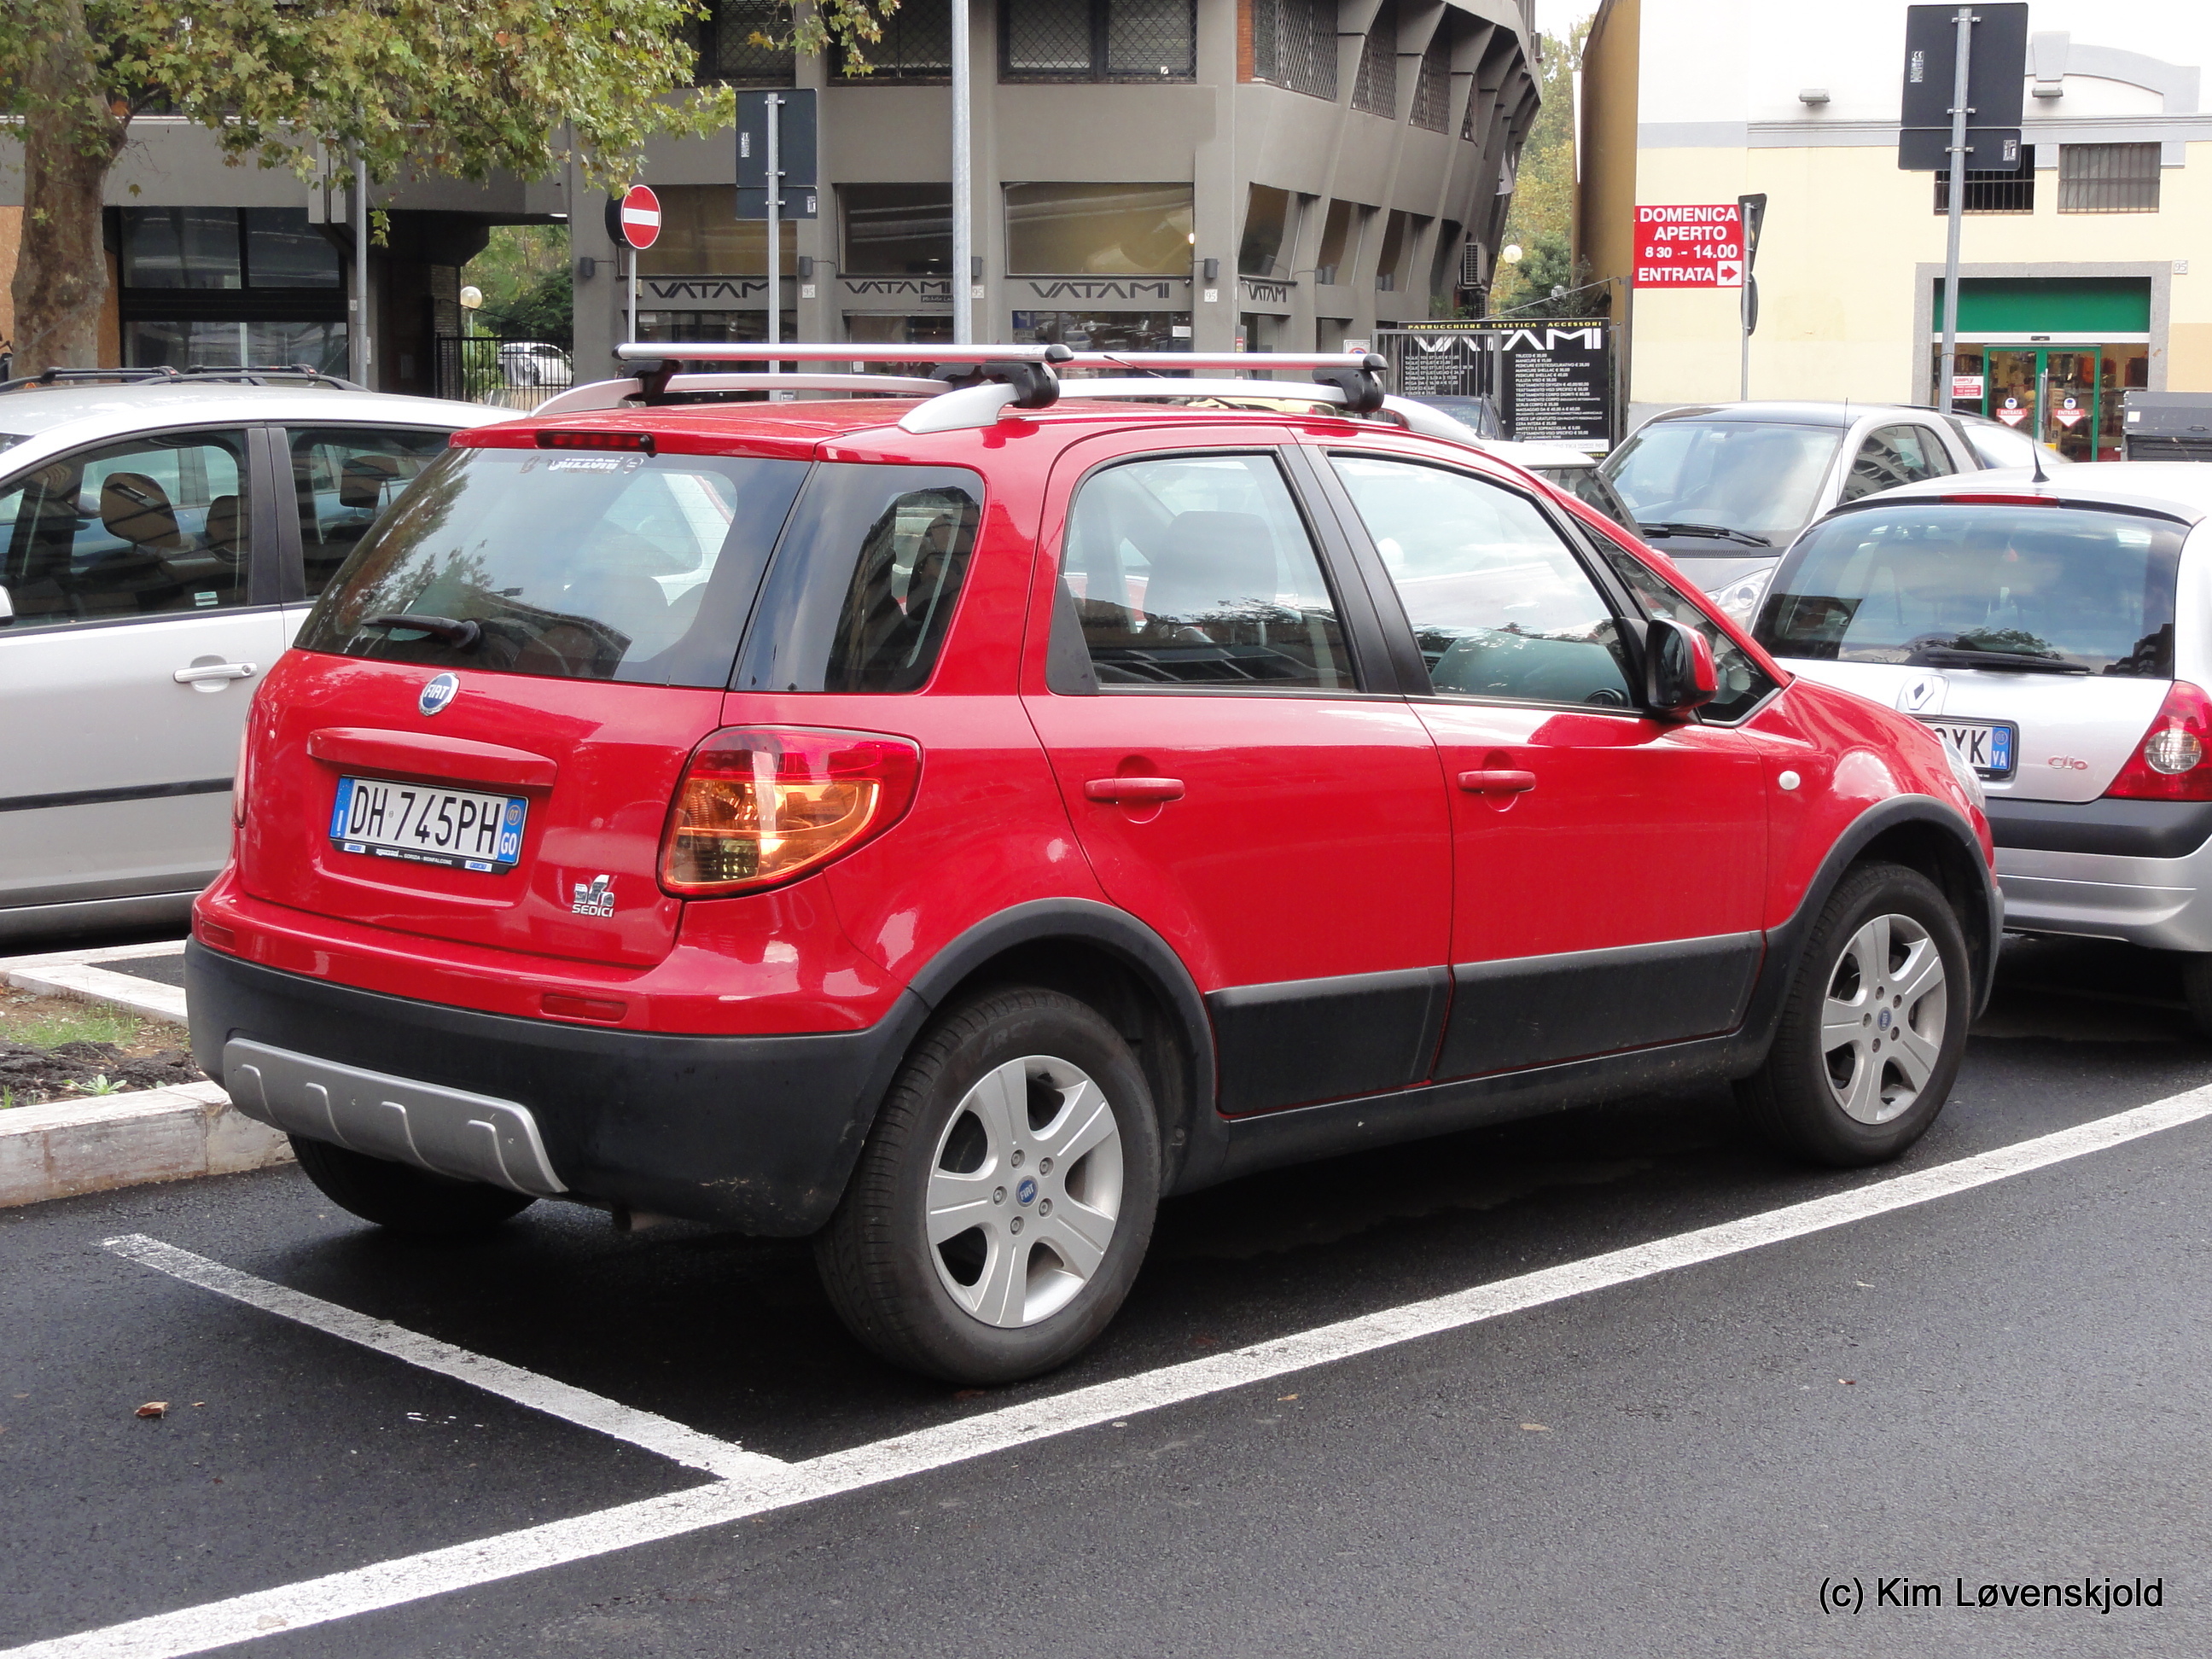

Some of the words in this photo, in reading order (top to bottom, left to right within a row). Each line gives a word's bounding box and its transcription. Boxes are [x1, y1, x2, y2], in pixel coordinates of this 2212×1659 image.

[1640, 207, 1738, 222] DOMENICA
[1654, 226, 1727, 240] APERTO
[1693, 244, 1738, 258] 14.00
[1639, 267, 1715, 281] ENTRATA
[649, 282, 769, 298] VATAM
[803, 287, 814, 296] 95
[845, 281, 951, 294] VATAMI
[972, 288, 983, 296] 95
[1029, 282, 1170, 298] VATAMI
[1205, 291, 1216, 301] 95
[423, 682, 450, 700] FIAT
[1992, 751, 2006, 766] VA
[350, 785, 389, 838] DH
[394, 791, 501, 855] 745PH
[508, 811, 518, 821] 07
[501, 832, 517, 855] GO
[572, 904, 614, 917] SEDICI
[1020, 1184, 1034, 1200] FIAT
